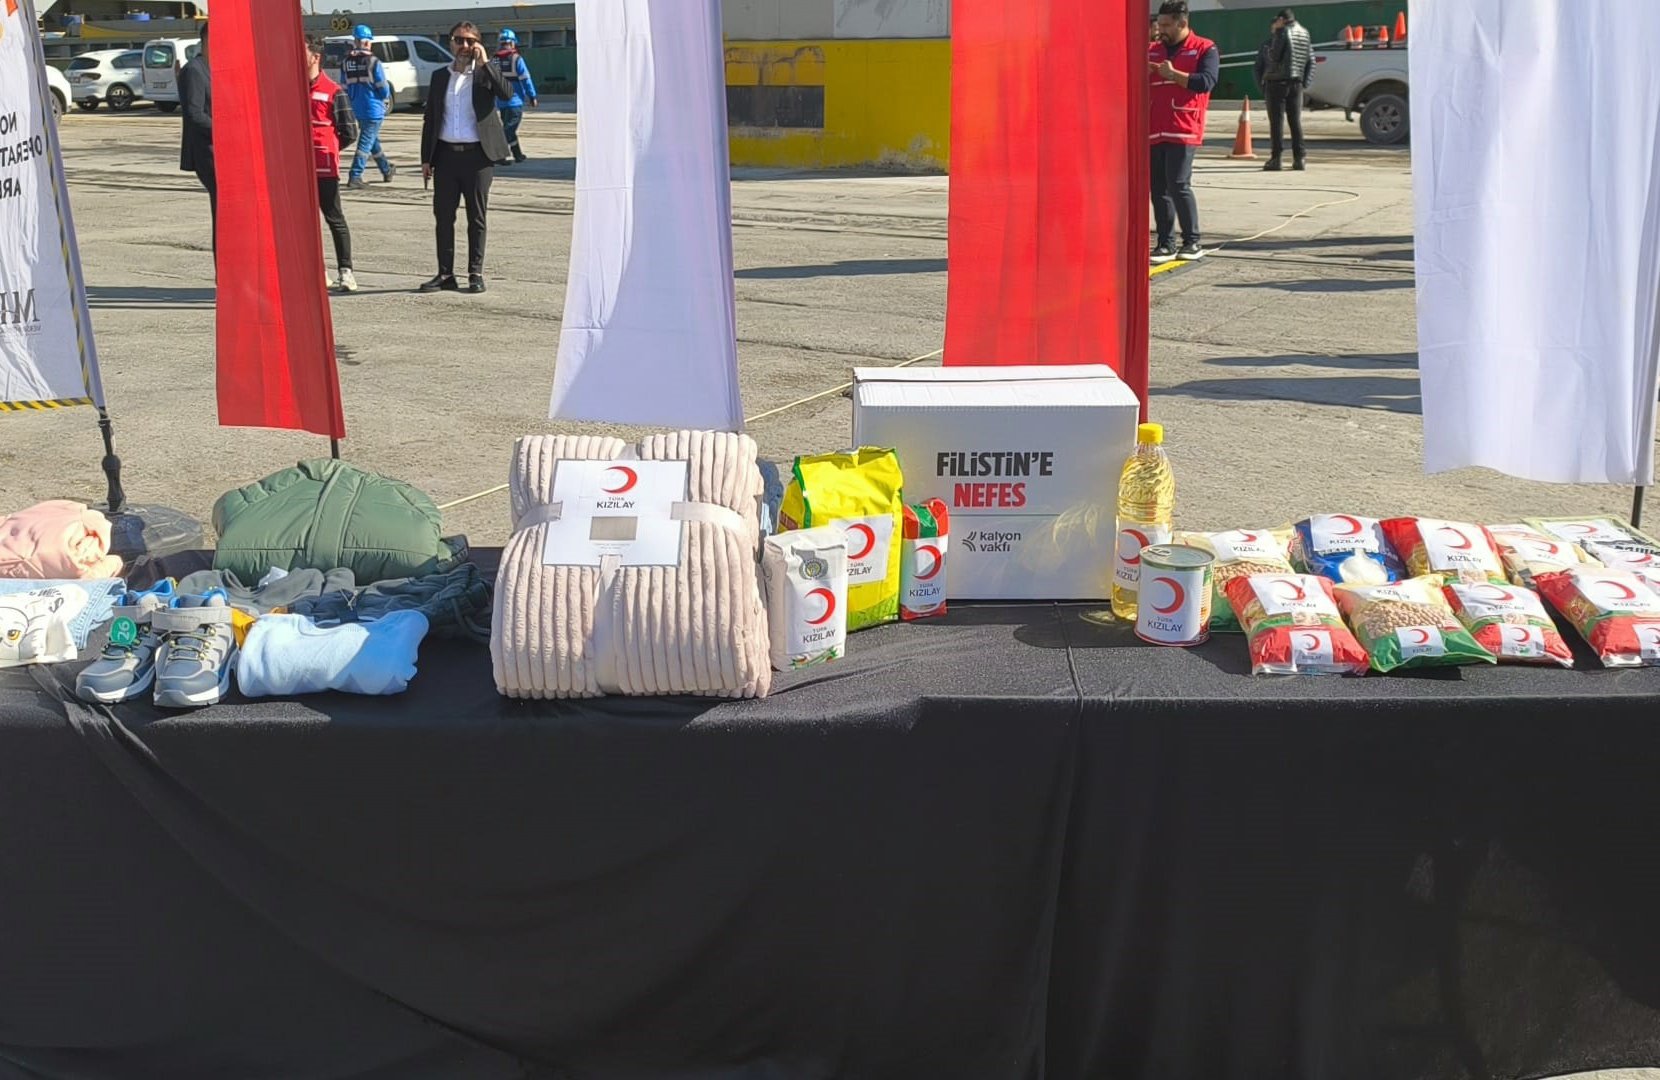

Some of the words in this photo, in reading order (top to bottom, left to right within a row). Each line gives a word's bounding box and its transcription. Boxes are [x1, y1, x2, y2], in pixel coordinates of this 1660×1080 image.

[954, 483, 1026, 507] NEFES
[596, 501, 635, 509] KIZILAY
[980, 531, 1021, 543] kalyon
[909, 586, 941, 597] KIZILAY
[1147, 619, 1184, 632] KIZILAY
[802, 629, 836, 644] KIZILAY
